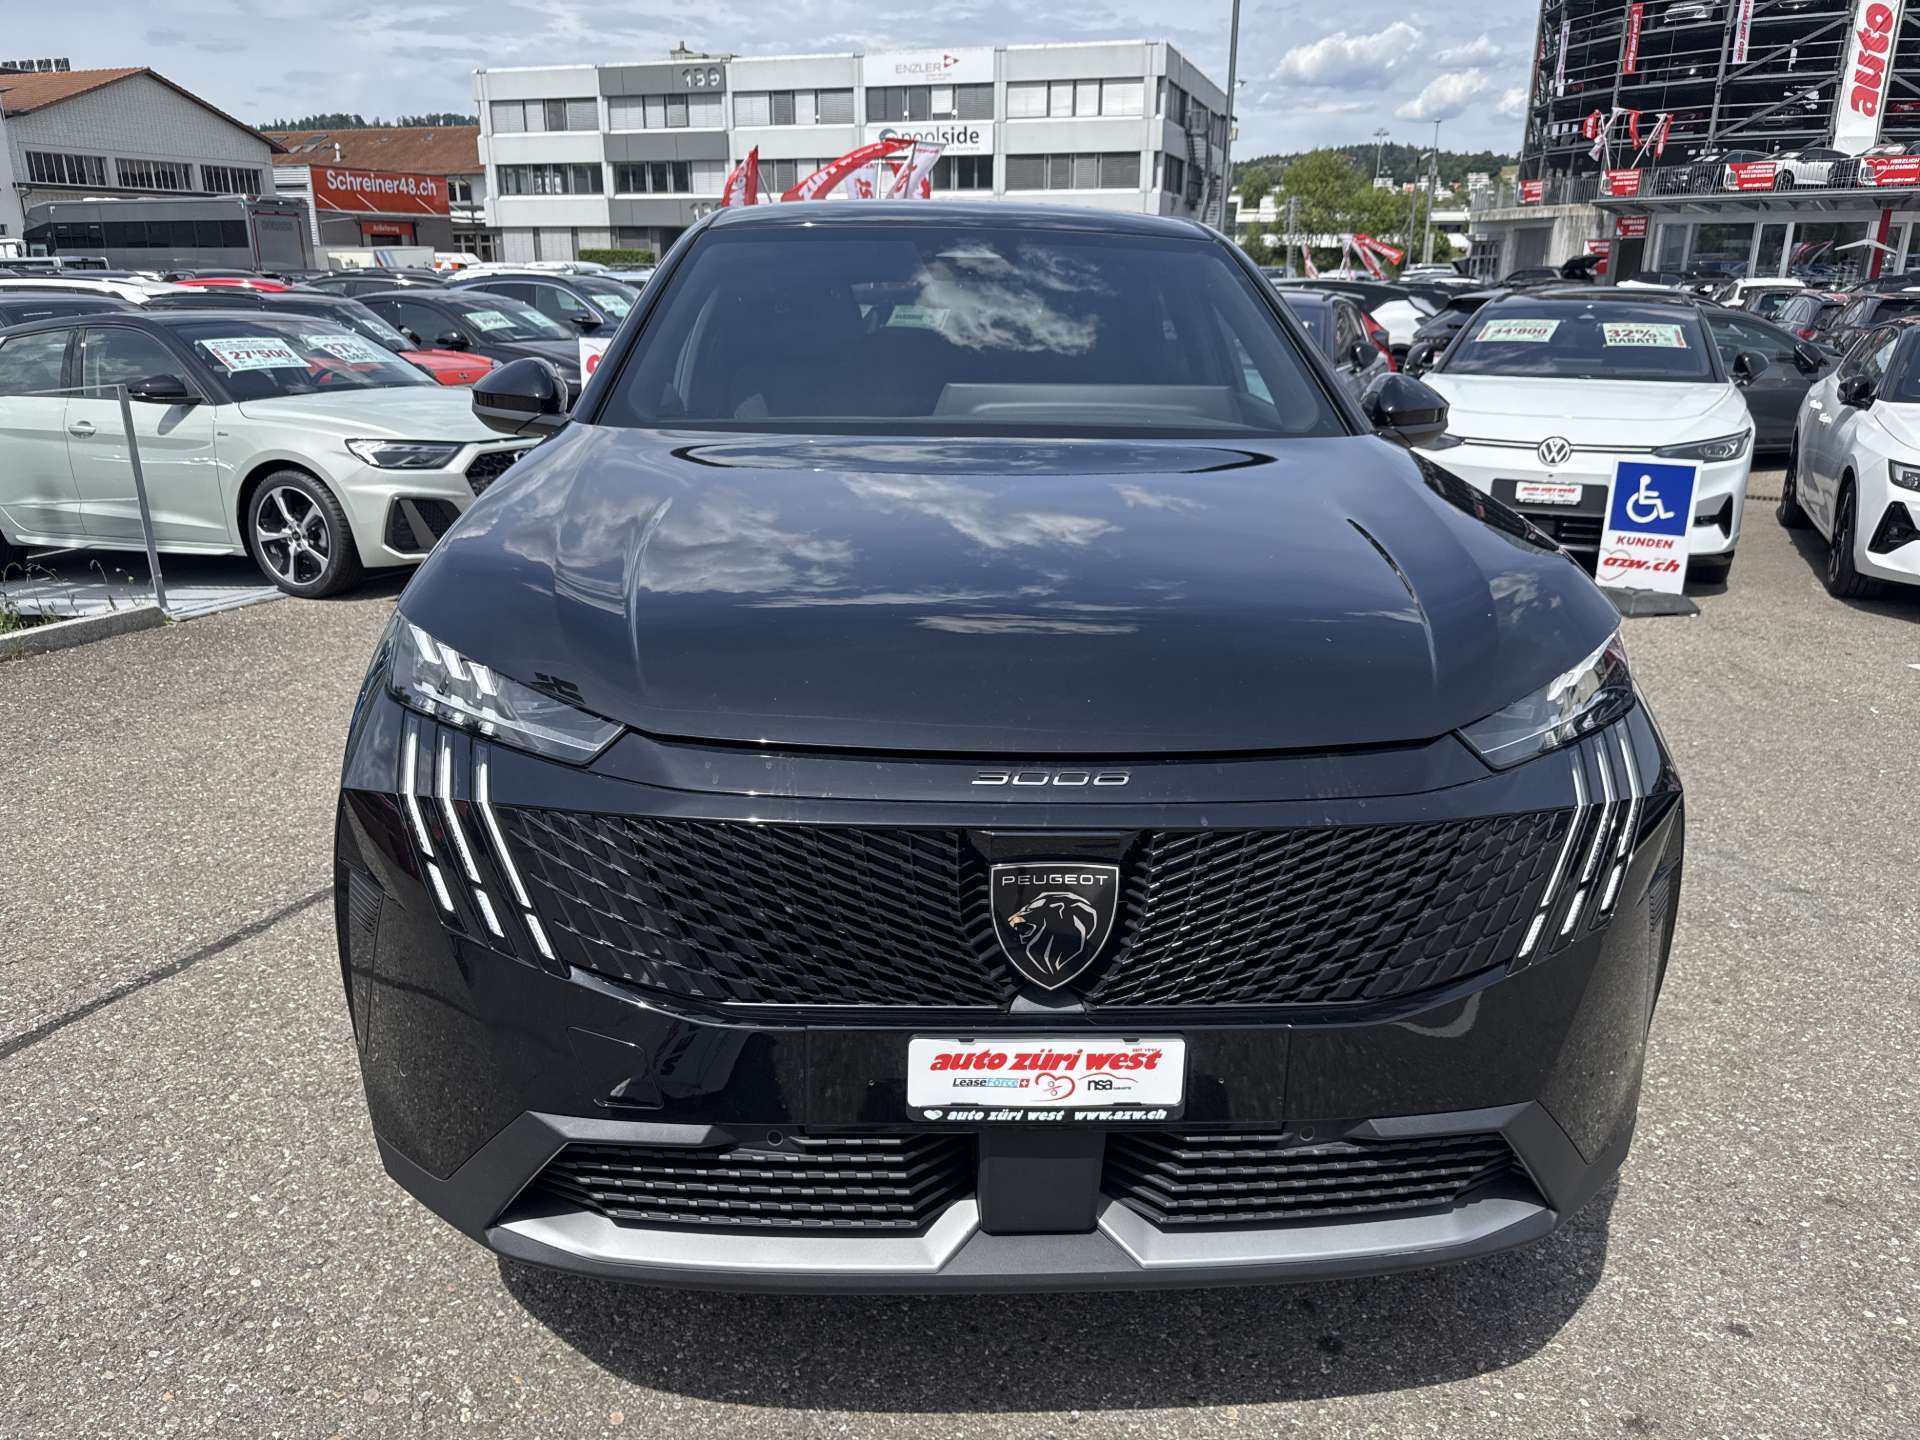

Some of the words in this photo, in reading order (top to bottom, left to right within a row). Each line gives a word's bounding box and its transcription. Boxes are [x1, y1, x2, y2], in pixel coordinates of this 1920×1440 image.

[1851, 3, 1894, 117] auto
[895, 62, 942, 75] ENZLER
[1876, 163, 1920, 171] WILLKOMMEN
[326, 169, 437, 196] Schreiner48.ch
[1607, 328, 1657, 338] 32%
[229, 349, 293, 360] 27'500
[1616, 535, 1675, 549] KUNDEN
[1603, 556, 1681, 573] azw.ch
[1001, 874, 1110, 886] PEUGEOT
[930, 1051, 1008, 1071] auto
[1010, 1049, 1084, 1071] züri
[1086, 1050, 1162, 1071] west
[952, 1077, 1018, 1088] LeaseForce
[1088, 1078, 1113, 1091] nsa
[947, 1109, 984, 1121] auto
[987, 1108, 1024, 1121] züri
[1027, 1109, 1064, 1121] west
[1074, 1109, 1168, 1121] www.azw.ch
